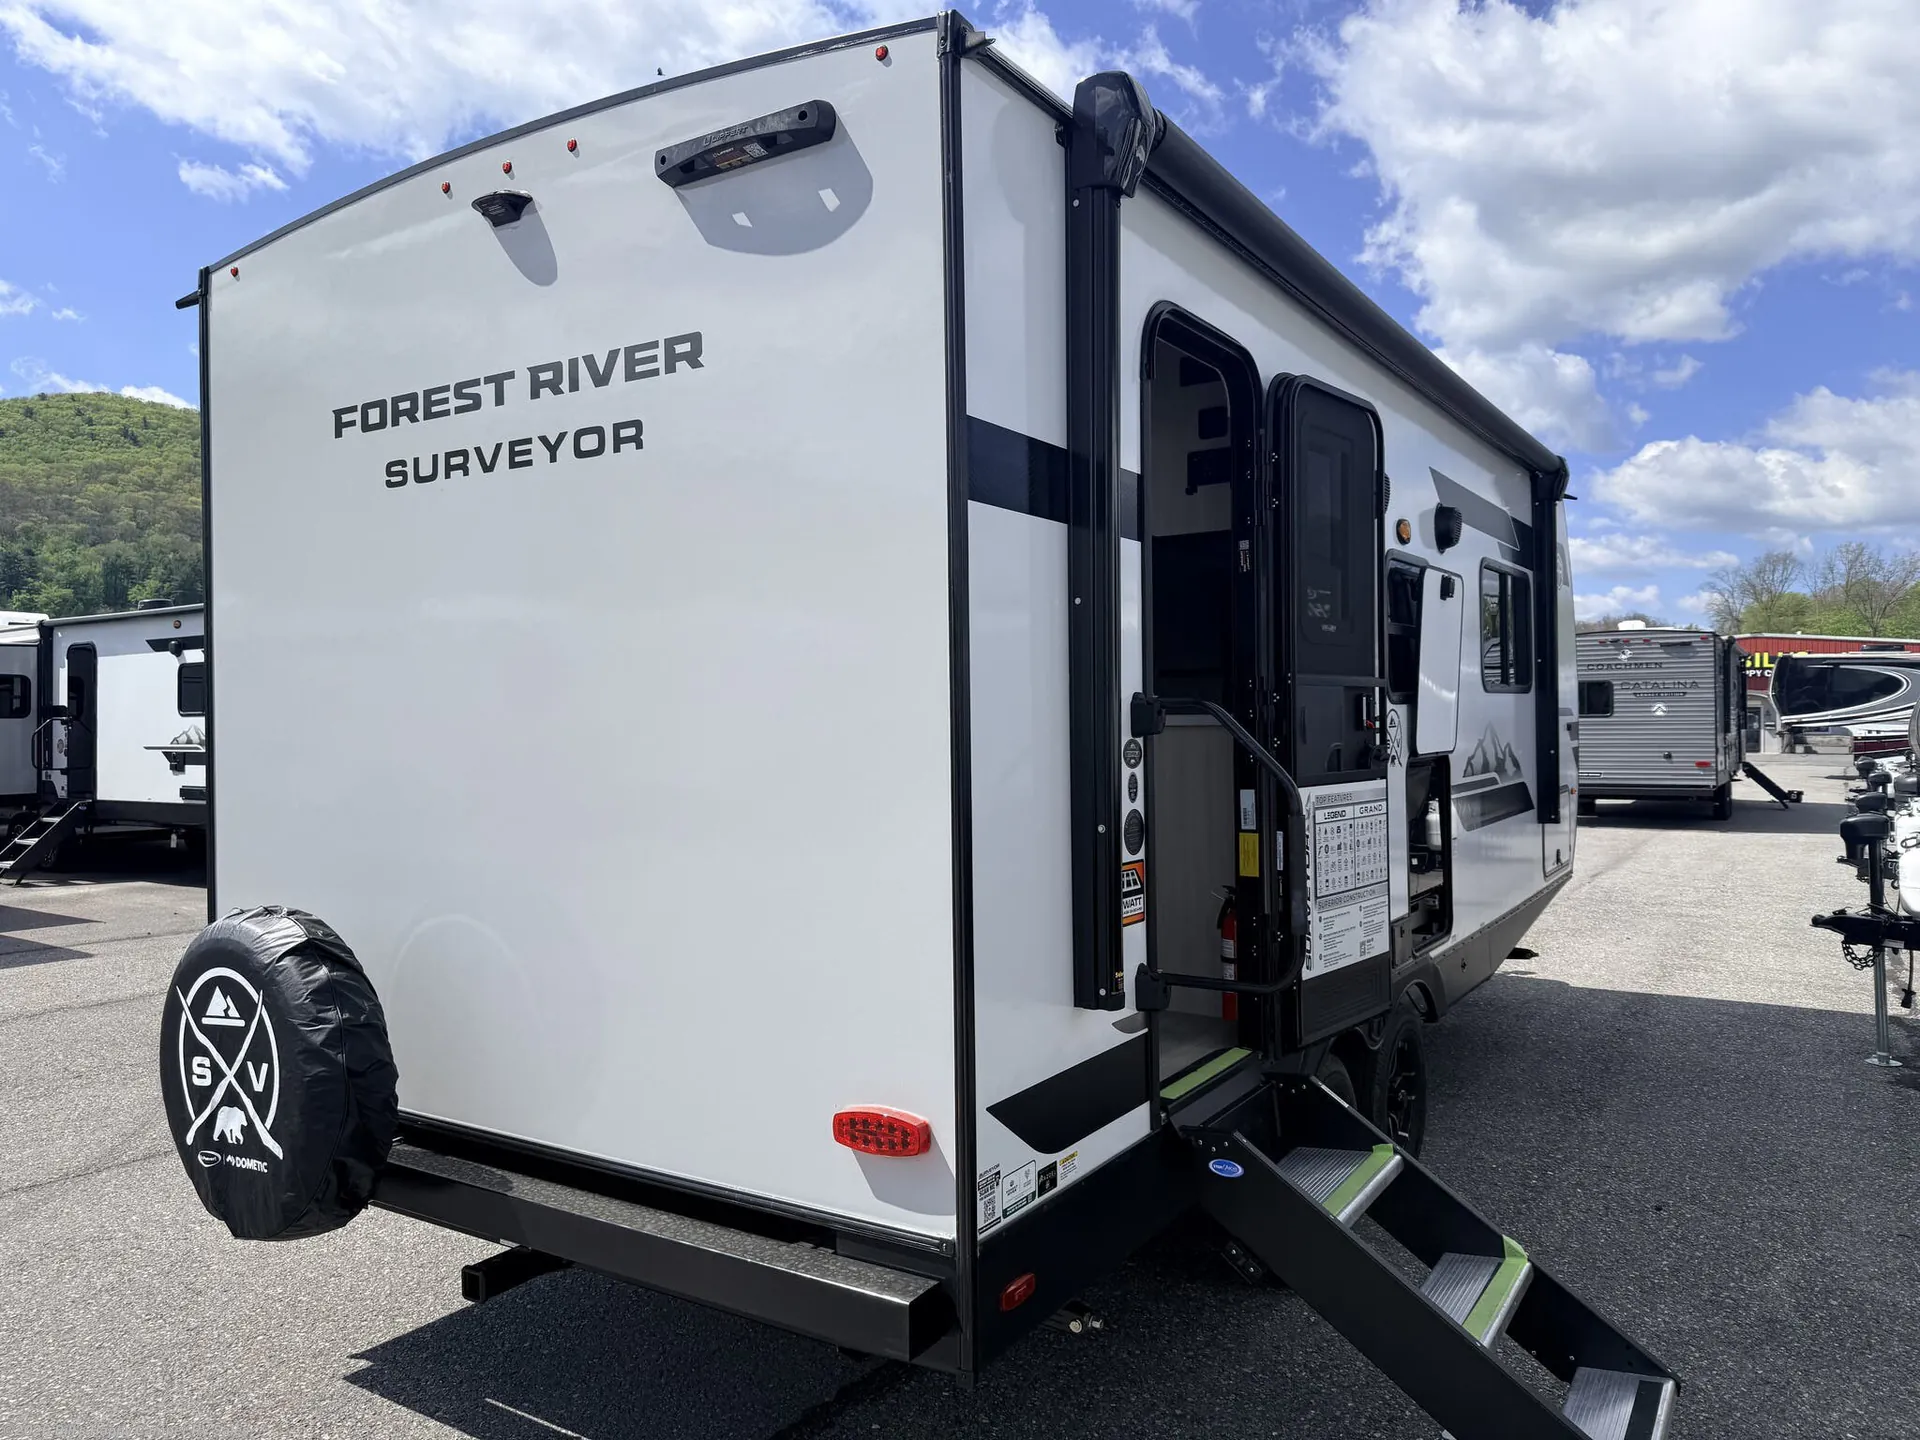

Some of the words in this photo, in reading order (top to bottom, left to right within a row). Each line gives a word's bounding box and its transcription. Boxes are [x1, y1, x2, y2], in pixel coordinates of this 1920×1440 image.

[332, 369, 516, 439] FOREST
[526, 331, 705, 401] RIVER
[385, 418, 645, 489] SURVEYOR
[1586, 662, 1663, 671] COACHMEN
[1620, 680, 1701, 690] CATALINA
[1327, 792, 1353, 803] FEATURES
[1323, 809, 1347, 821] LEGEND
[1359, 803, 1383, 815] GRAND
[1122, 896, 1142, 910] WATT
[191, 1056, 212, 1087] S
[246, 1060, 269, 1093] V
[235, 1156, 268, 1174] DOMETIC
